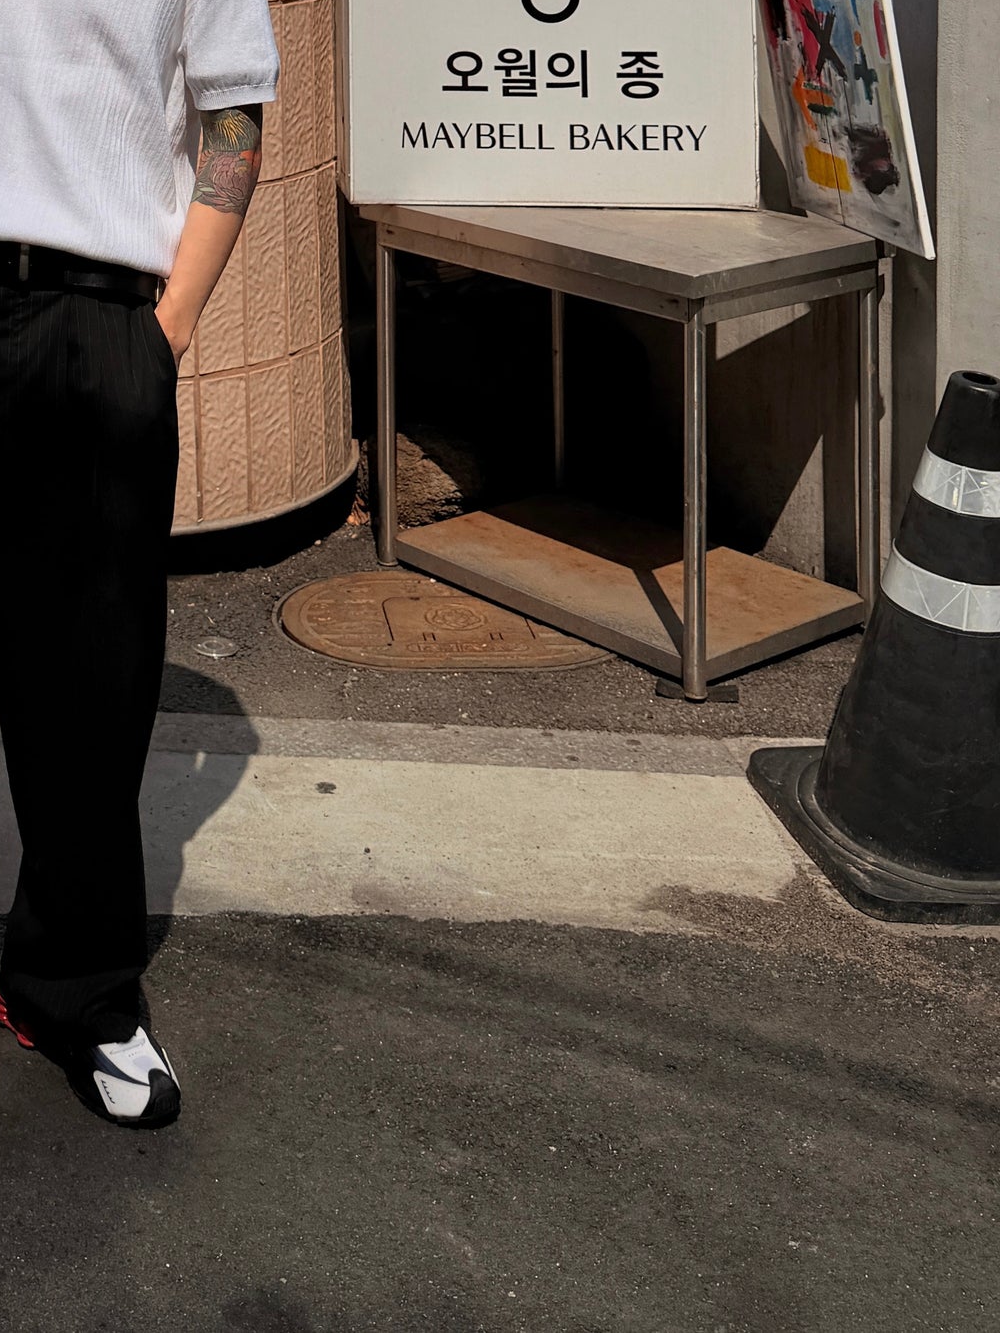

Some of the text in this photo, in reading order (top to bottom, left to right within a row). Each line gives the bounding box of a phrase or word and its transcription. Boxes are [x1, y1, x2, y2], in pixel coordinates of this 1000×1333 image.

[441, 47, 664, 100] 오월의 종
[401, 121, 708, 152] MAYBELL BAKERY
